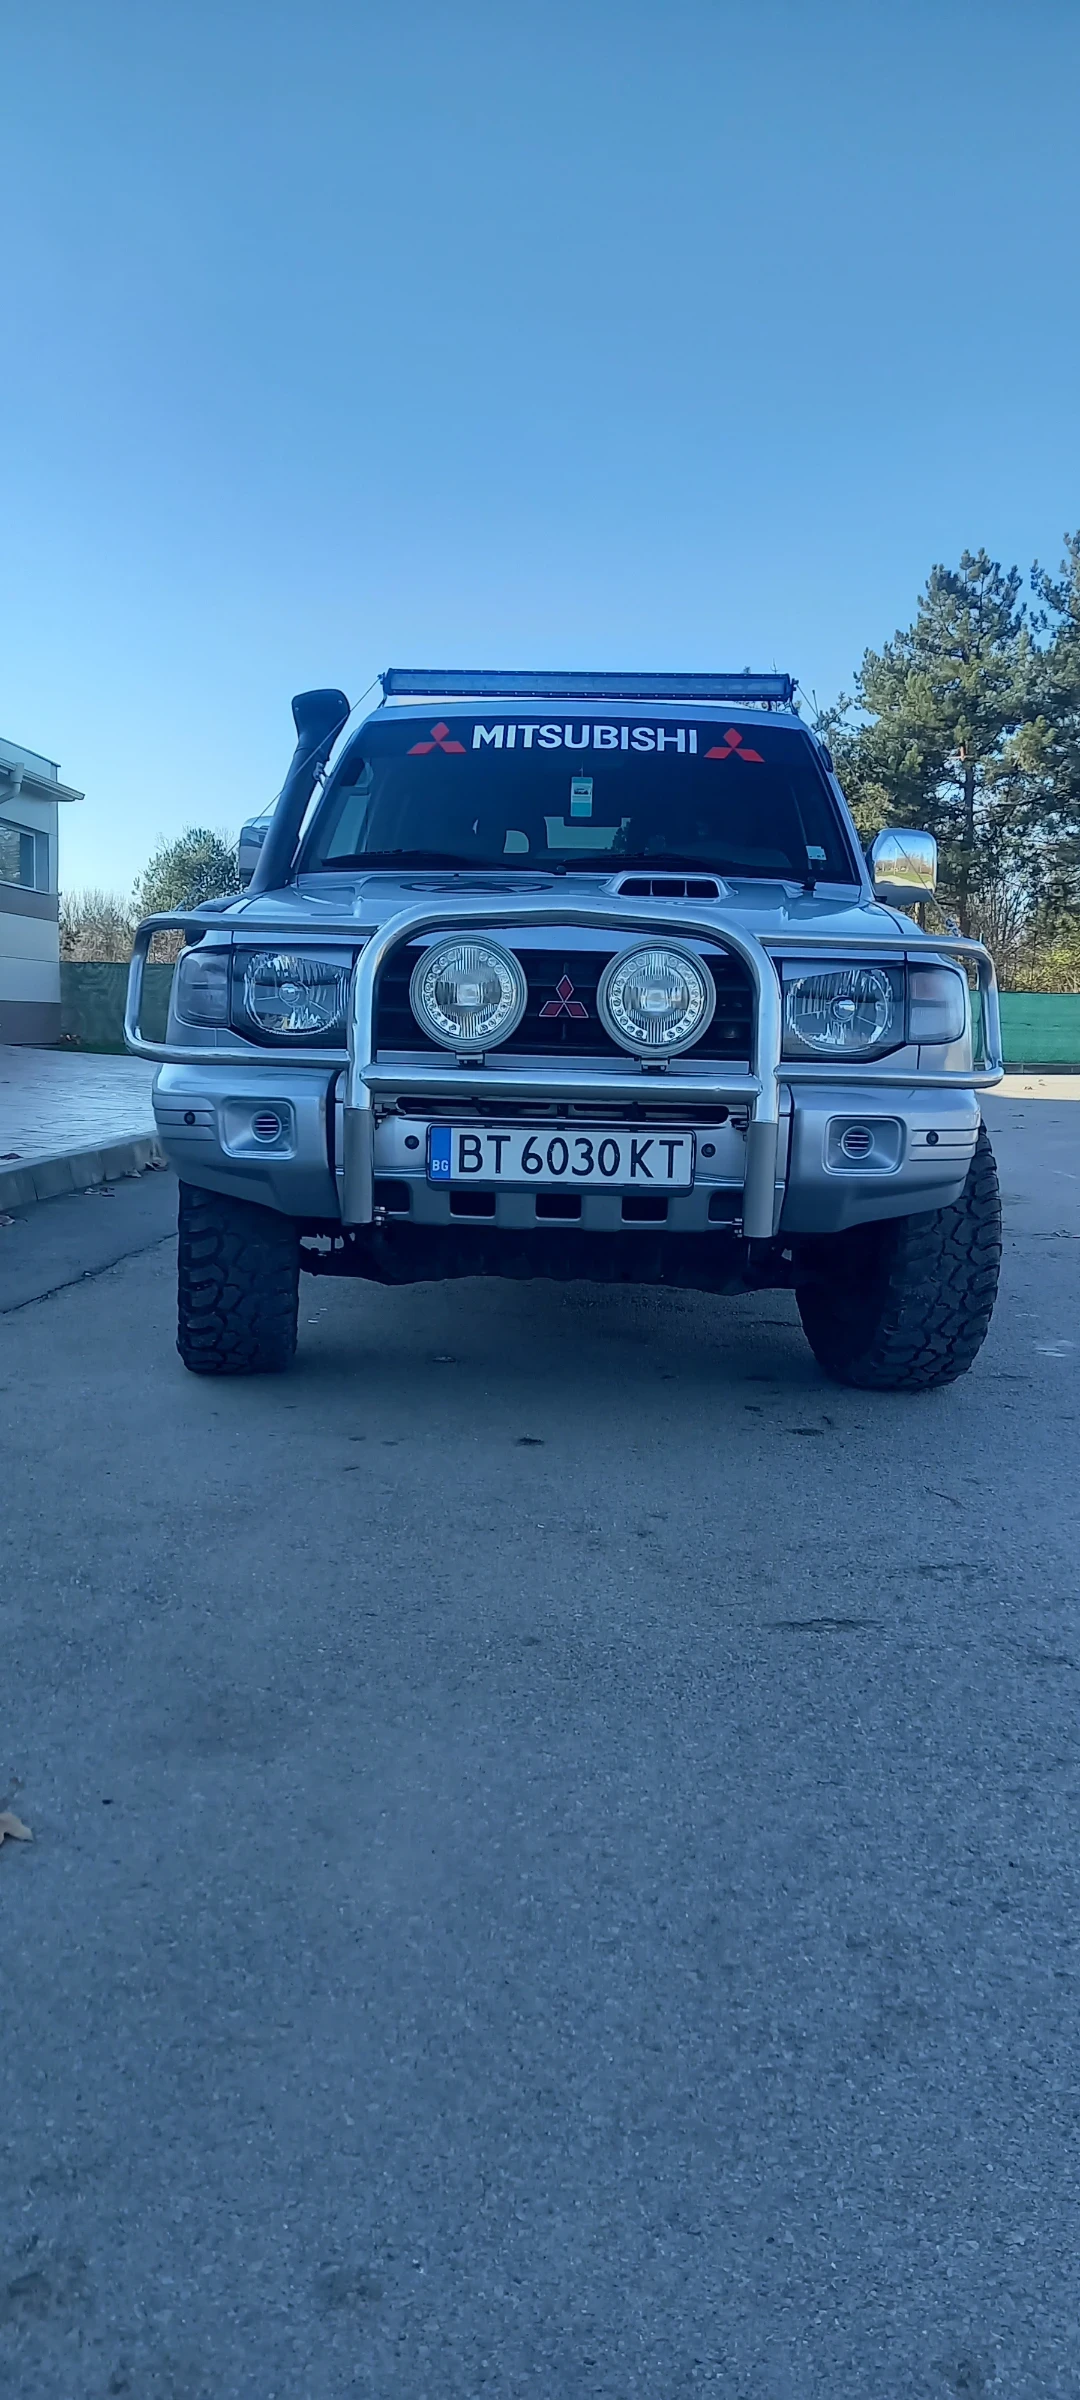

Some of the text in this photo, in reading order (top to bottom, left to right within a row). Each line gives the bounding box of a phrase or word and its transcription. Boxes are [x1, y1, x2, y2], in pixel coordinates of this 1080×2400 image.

[472, 724, 698, 754] MITSUBISHI
[432, 1160, 449, 1172] BG
[458, 1134, 684, 1178] BT 6030 KT
